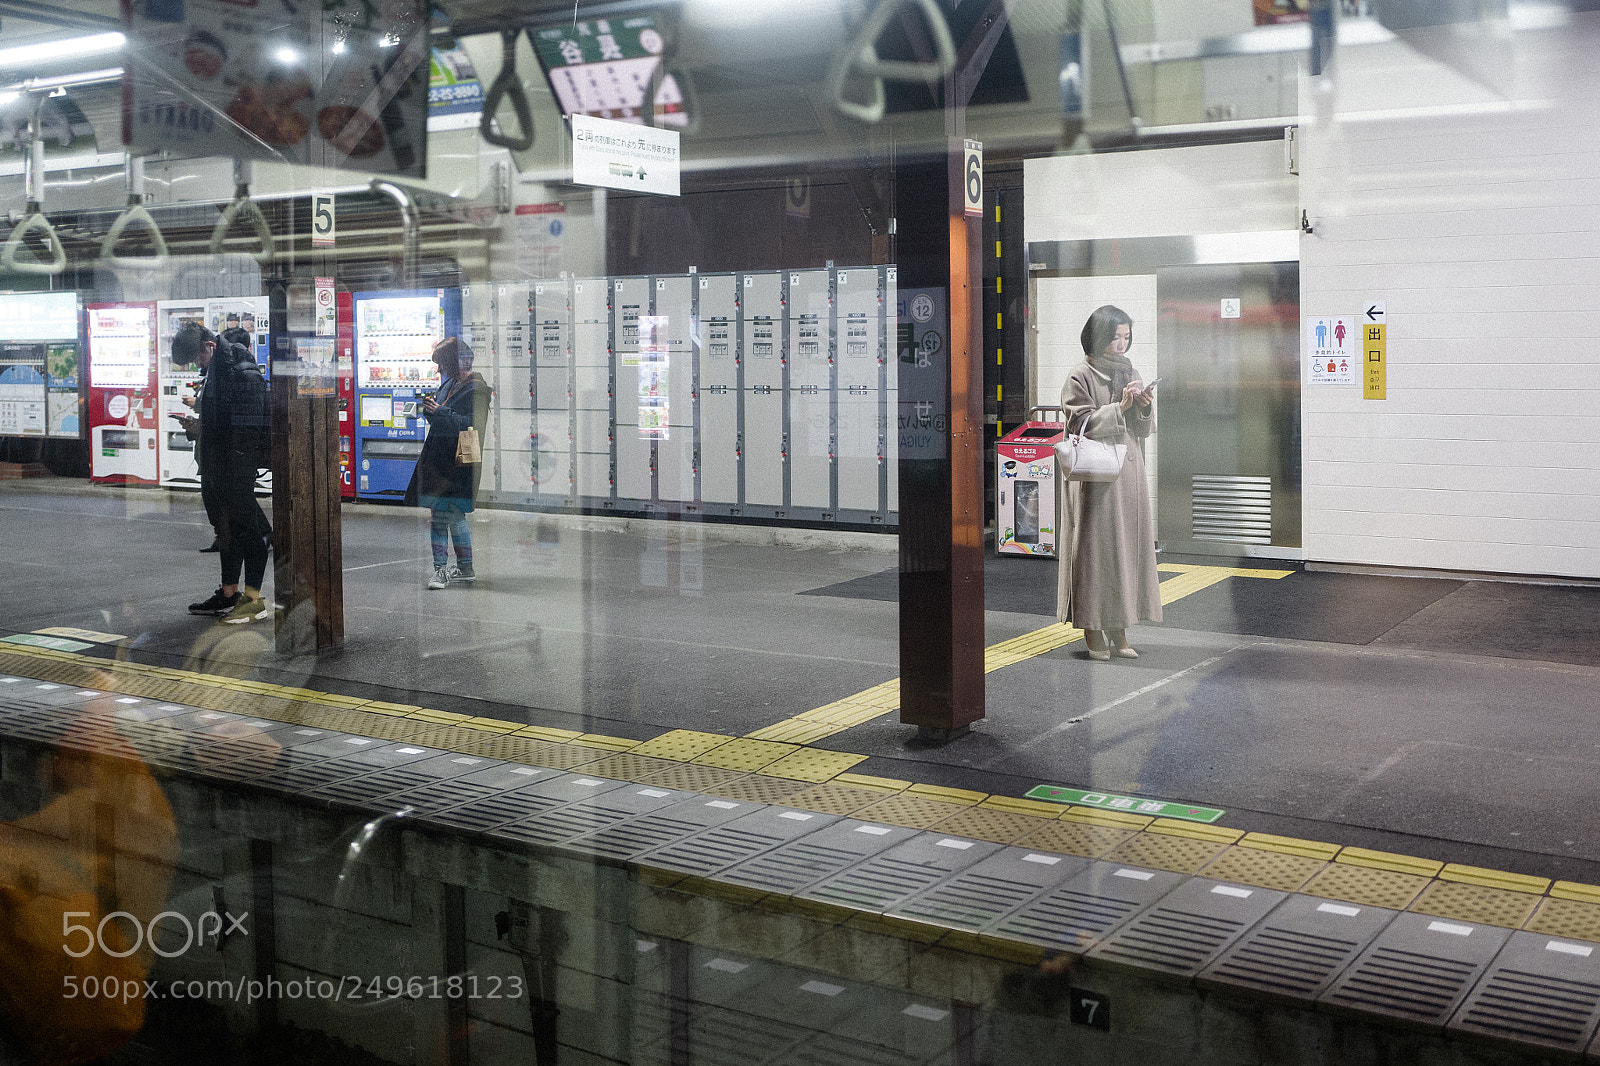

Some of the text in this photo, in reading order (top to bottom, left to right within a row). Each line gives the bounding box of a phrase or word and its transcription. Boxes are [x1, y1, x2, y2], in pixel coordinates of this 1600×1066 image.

[967, 154, 981, 204] 6
[315, 197, 332, 234] 5
[916, 305, 930, 317] 12
[1368, 327, 1382, 363] 出口
[1081, 998, 1100, 1025] 7
